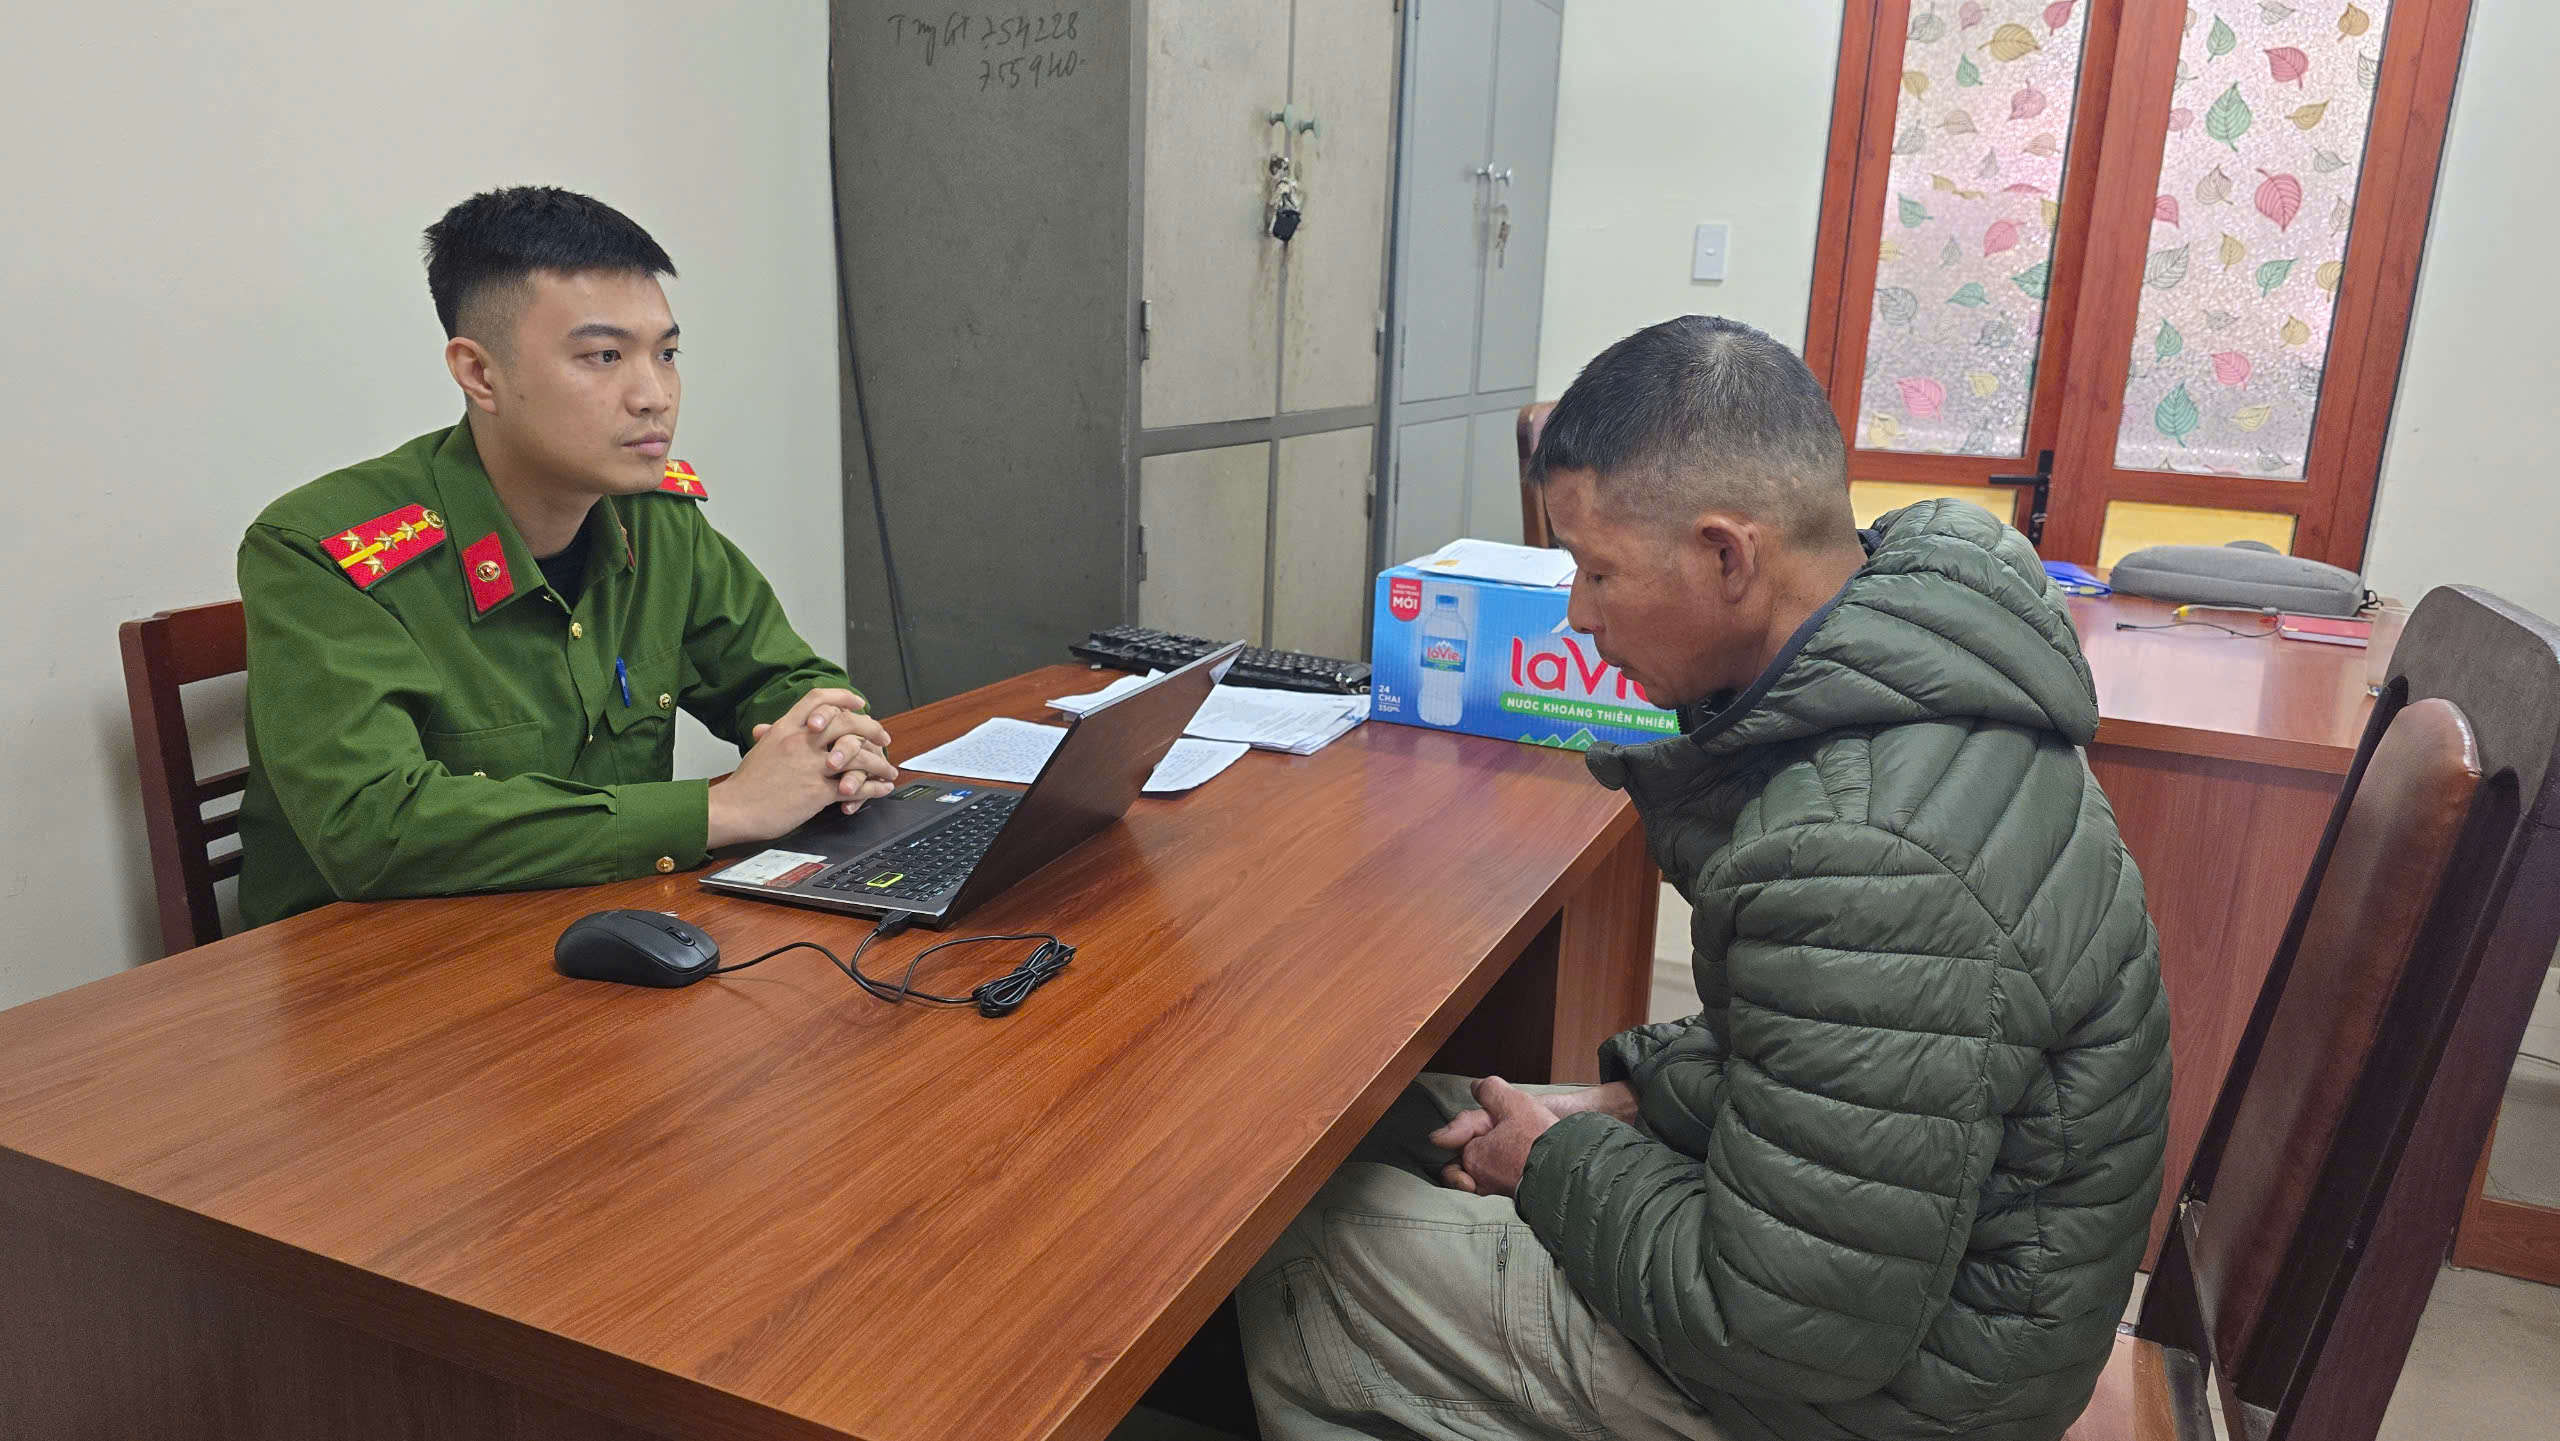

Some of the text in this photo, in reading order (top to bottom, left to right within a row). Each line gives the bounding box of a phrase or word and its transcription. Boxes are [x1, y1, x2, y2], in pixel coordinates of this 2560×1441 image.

[1378, 684, 1390, 693] 24
[1378, 694, 1400, 704] CHAI
[1506, 697, 1675, 730] NƯỚC KHOÁNG THIÊN NHIÊN
